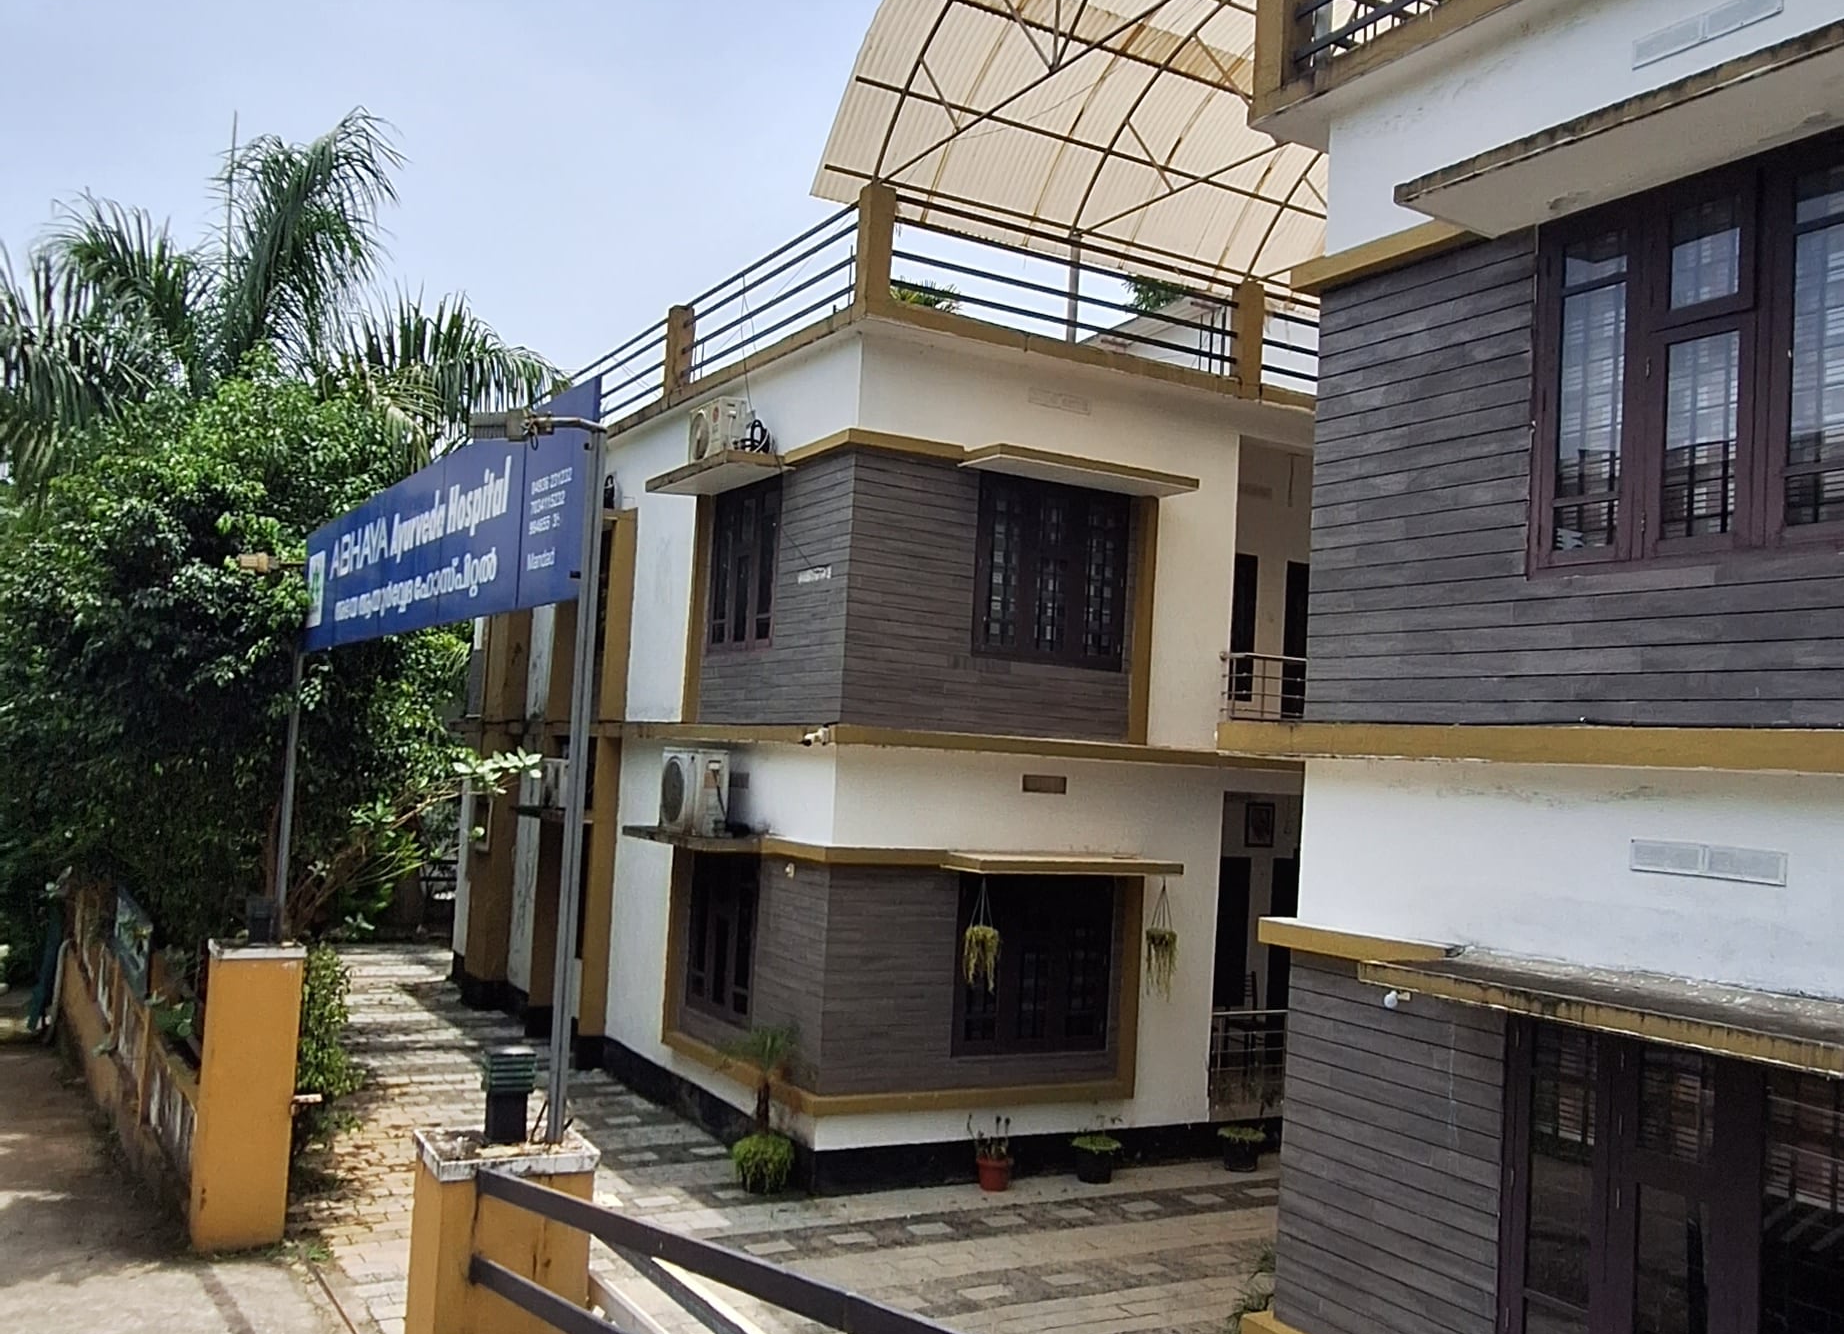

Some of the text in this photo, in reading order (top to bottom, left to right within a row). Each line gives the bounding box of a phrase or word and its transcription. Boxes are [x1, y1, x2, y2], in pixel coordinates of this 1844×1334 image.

[328, 455, 512, 580] ABHAYA Ayurveda Hospital
